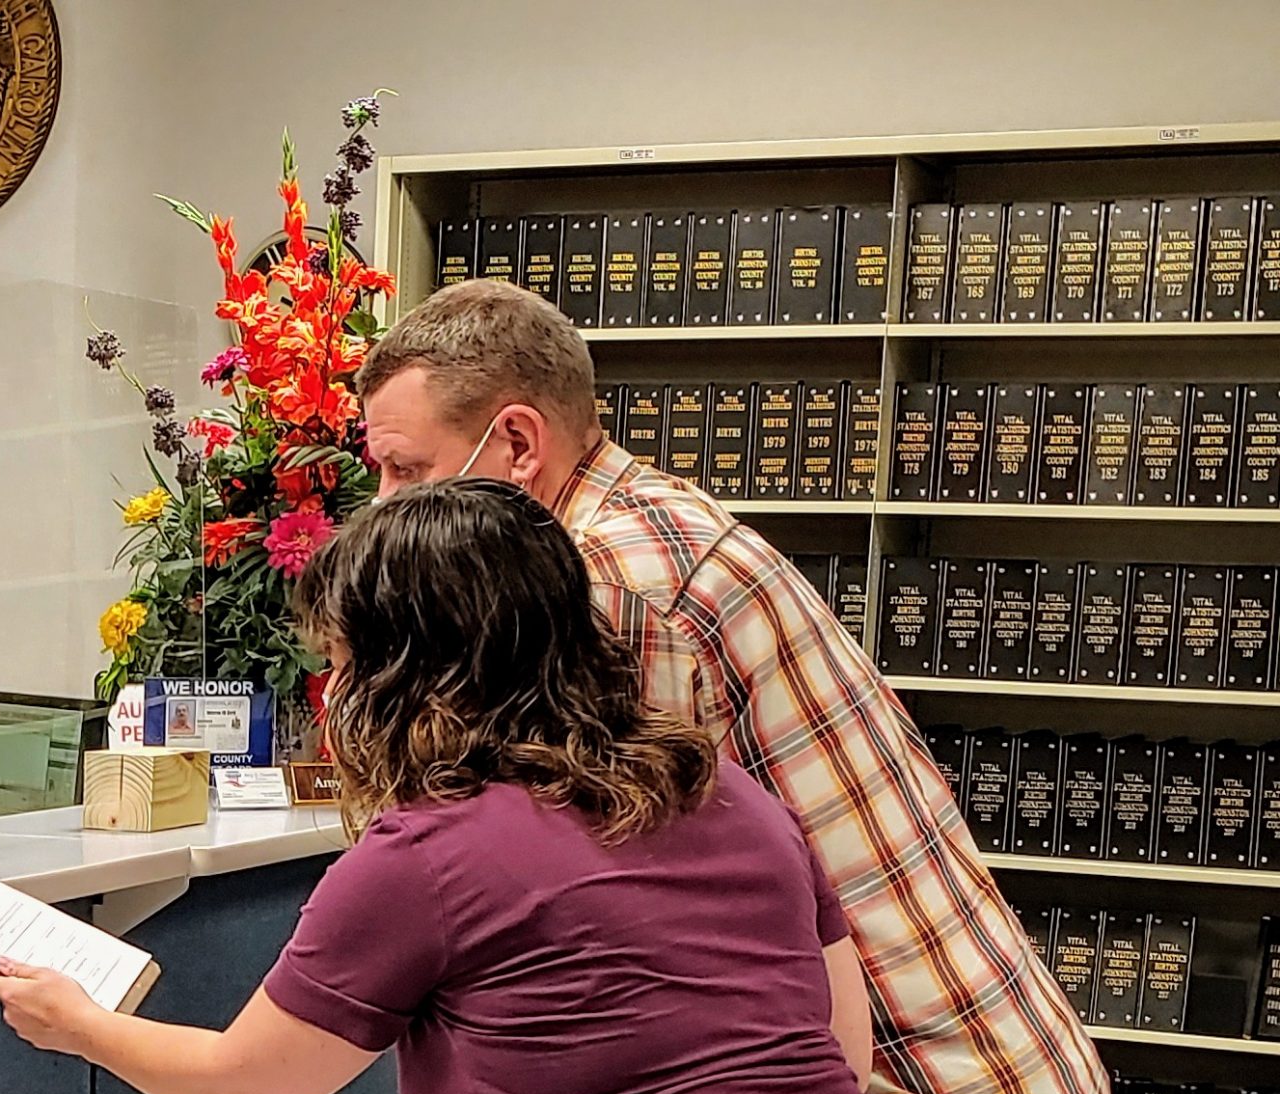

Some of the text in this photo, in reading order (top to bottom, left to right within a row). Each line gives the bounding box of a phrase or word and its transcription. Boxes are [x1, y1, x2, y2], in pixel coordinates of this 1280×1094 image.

[917, 288, 933, 299] 167
[1018, 287, 1034, 298] 169
[1166, 284, 1182, 295] 172
[1217, 284, 1234, 295] 173
[763, 418, 789, 427] BIRTHS
[808, 418, 832, 427] BIRTHS
[716, 428, 741, 437] BIRTHS
[763, 437, 785, 448] 1979
[808, 437, 830, 448] 1979
[953, 463, 968, 475] 179
[1052, 467, 1066, 478] 181
[1101, 468, 1118, 479] 182
[1150, 469, 1166, 479] 183
[1200, 469, 1216, 480] 184
[1252, 469, 1269, 480] 185
[775, 478, 789, 486] 109
[819, 478, 832, 486] 110
[900, 635, 916, 646] 189
[162, 681, 254, 695] WE HONOR
[213, 755, 253, 763] COUNTY
[314, 778, 342, 790] Amy
